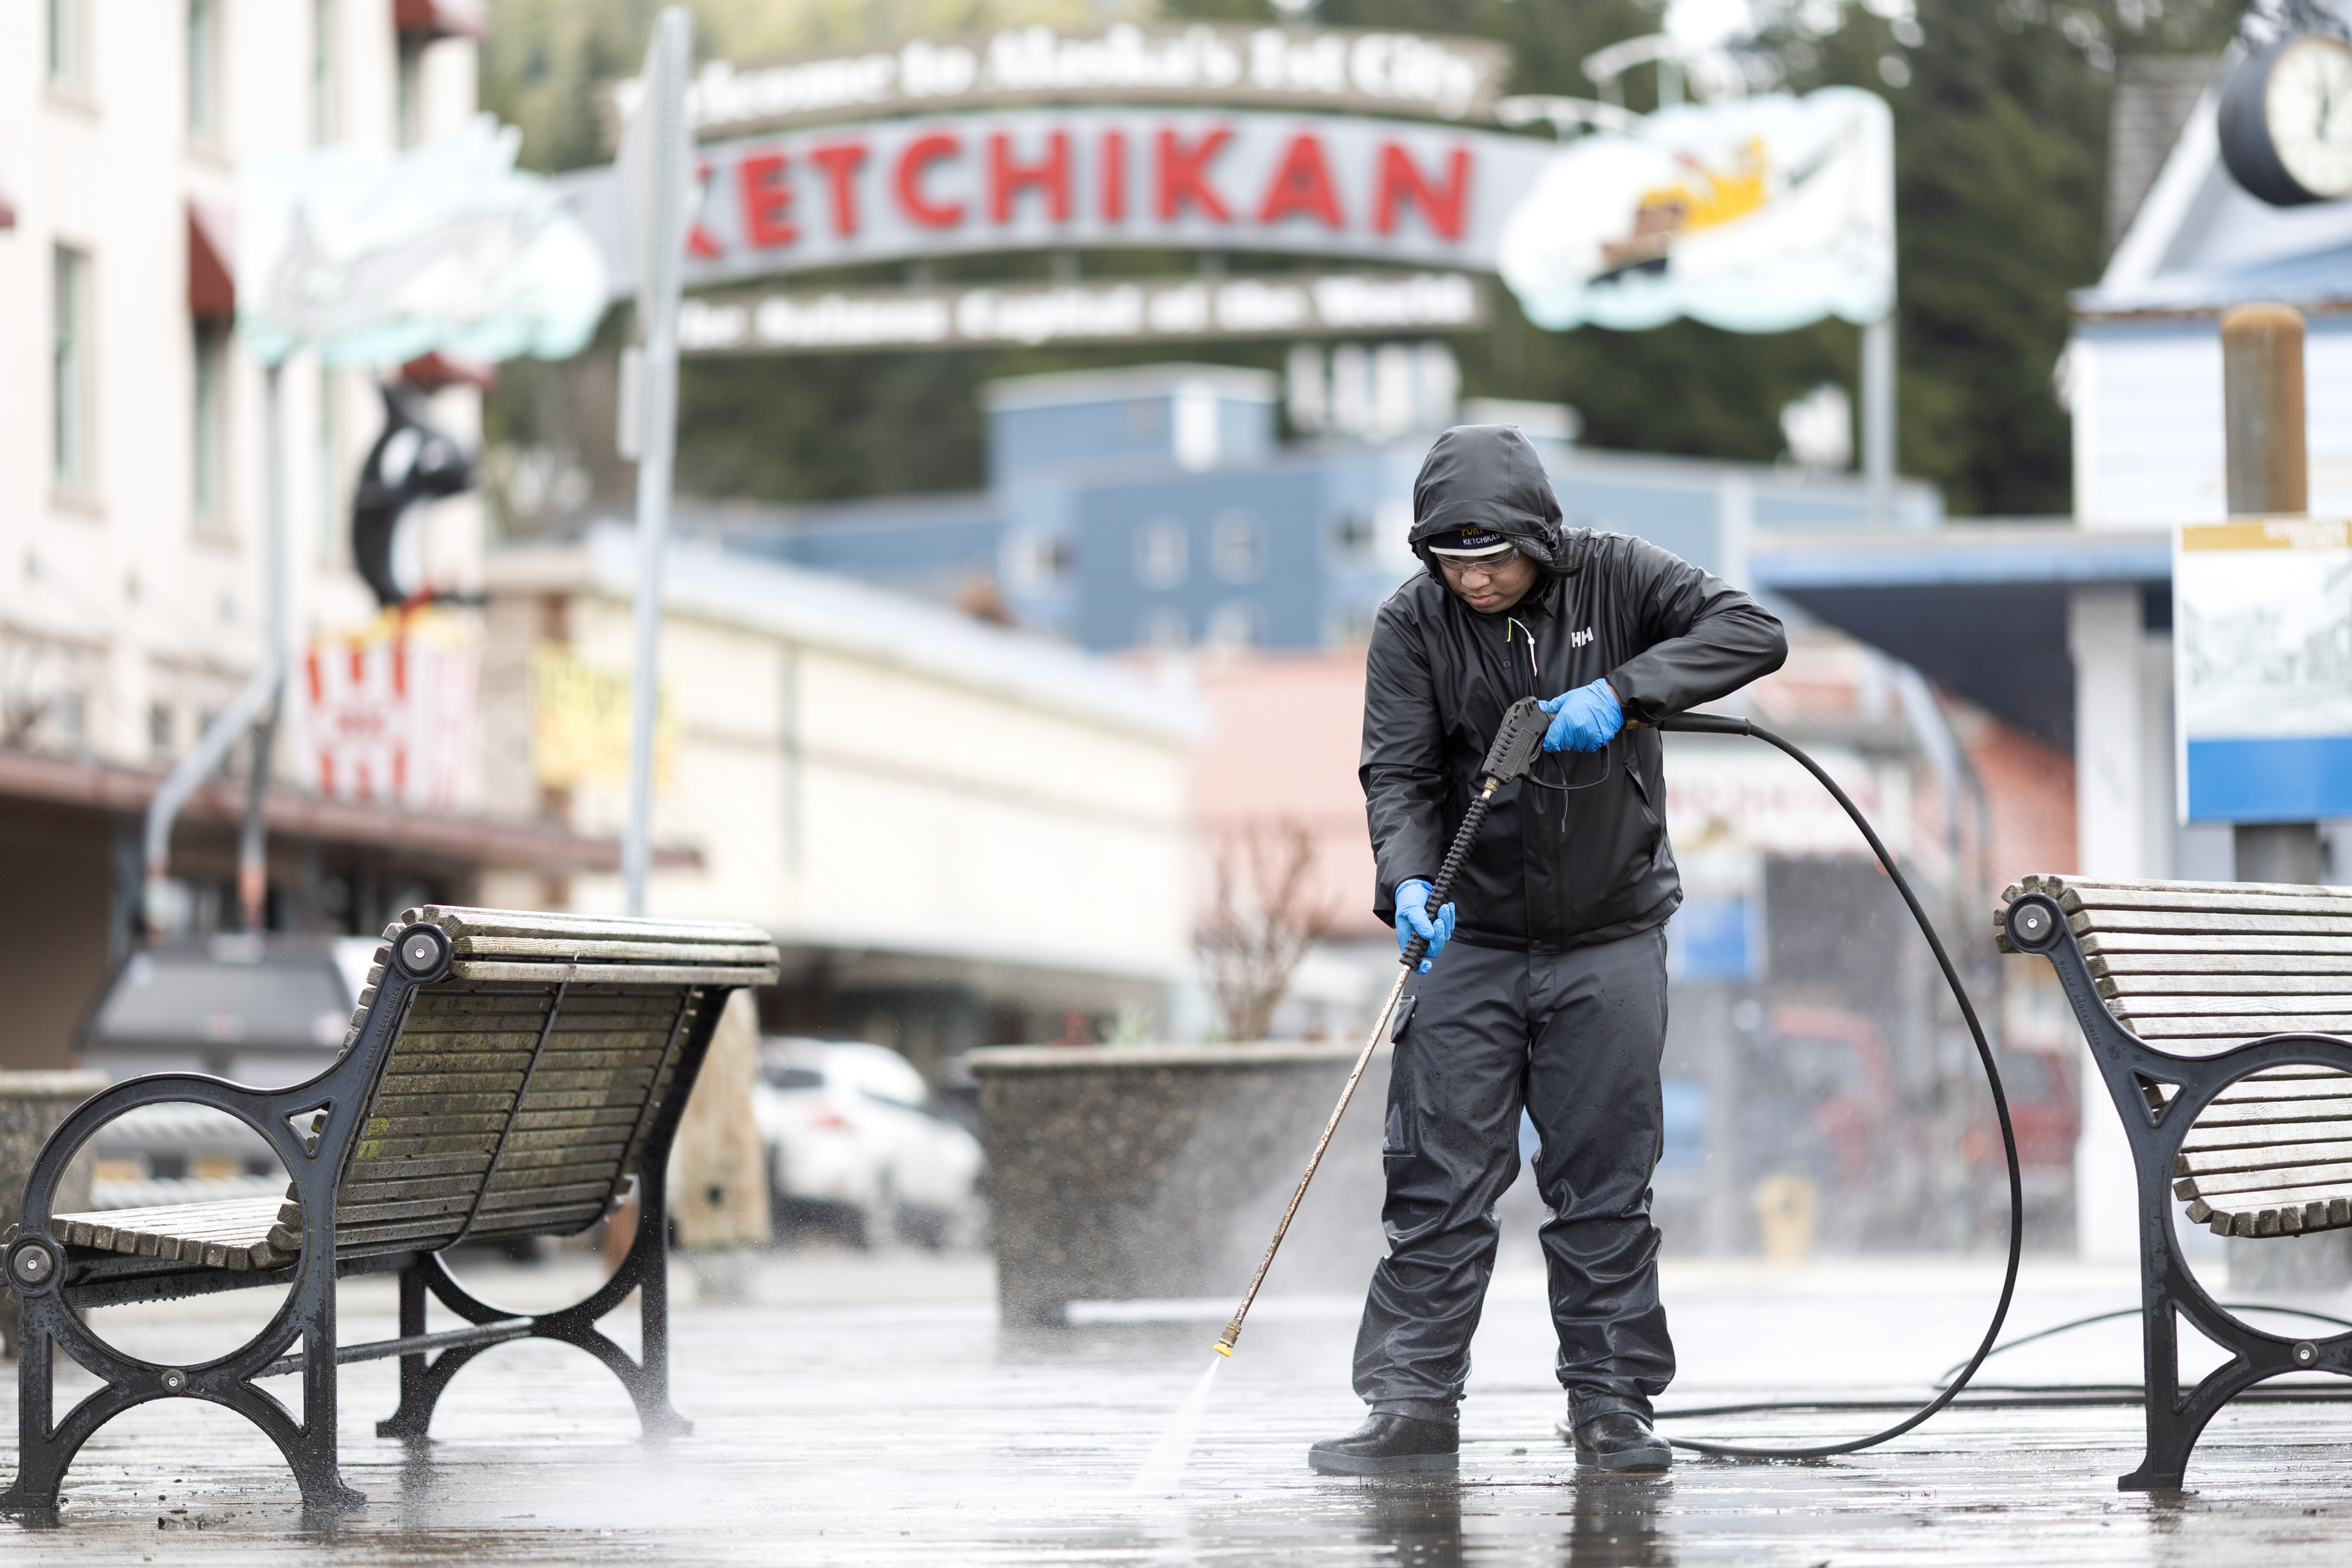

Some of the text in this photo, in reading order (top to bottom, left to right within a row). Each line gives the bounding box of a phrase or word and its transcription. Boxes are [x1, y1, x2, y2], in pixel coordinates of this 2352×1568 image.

[1463, 532, 1500, 545] KETCHIKAN
[1571, 626, 1594, 648] HH
[363, 985, 401, 1069] URBAN ACCESSORIES
